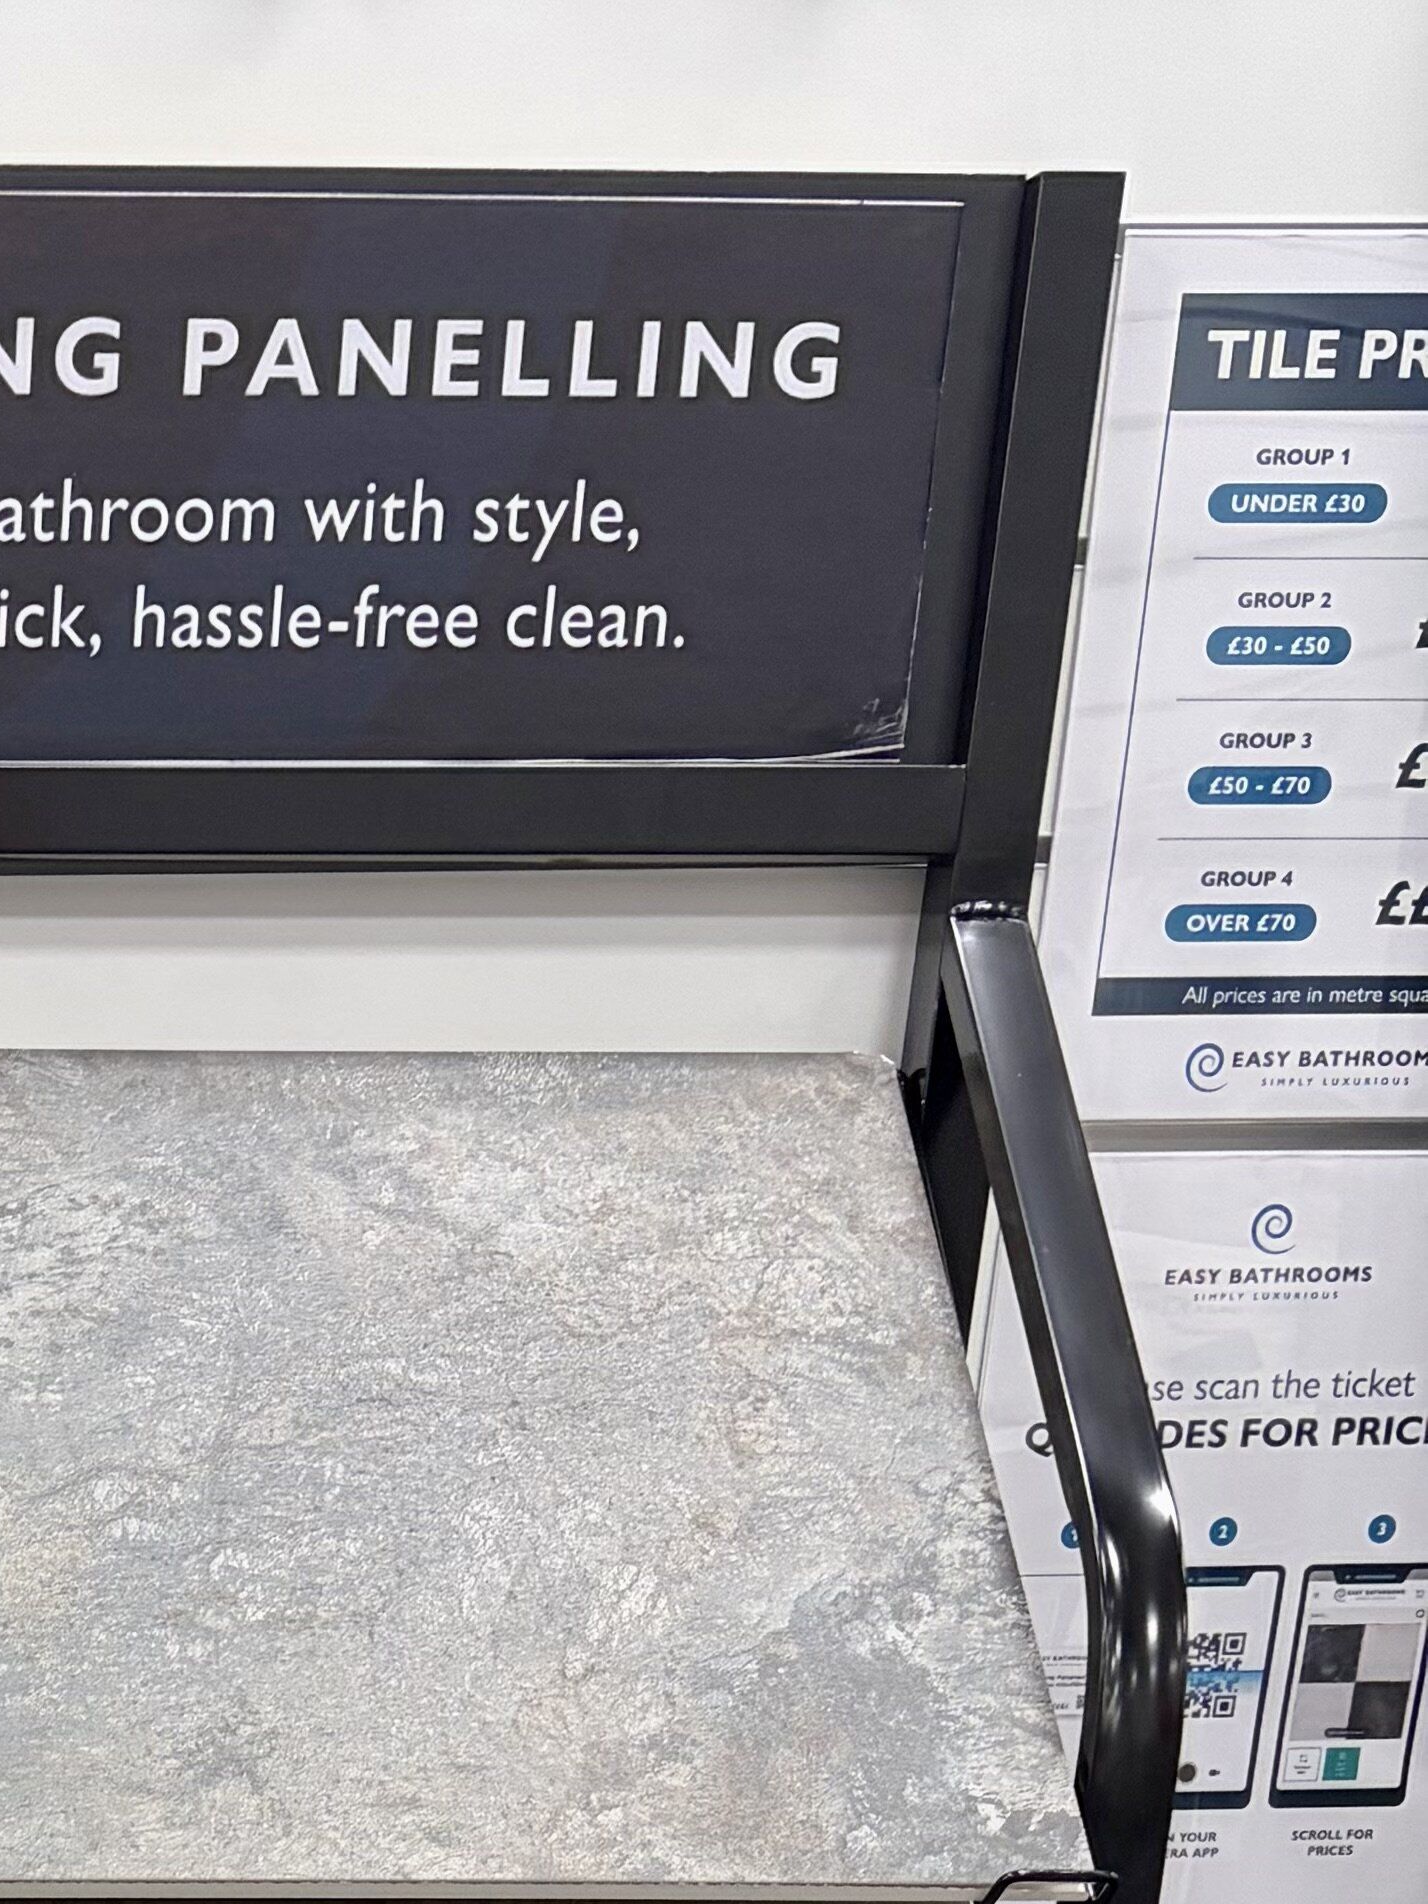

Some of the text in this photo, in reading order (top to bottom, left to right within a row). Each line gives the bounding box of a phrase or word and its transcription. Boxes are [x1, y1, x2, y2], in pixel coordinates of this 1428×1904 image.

[183, 318, 839, 399] PANELLING
[1208, 330, 1428, 378] TILE PR
[1257, 449, 1349, 465] GROUP 1
[1232, 494, 1365, 512] UNDER £30
[305, 479, 443, 541] with
[474, 479, 638, 562] style,
[1238, 592, 1331, 608] GROUP 2
[134, 585, 478, 647] hassle-free
[507, 585, 684, 647] clean.
[1228, 637, 1267, 654] £30
[1291, 637, 1329, 654] £50
[1220, 733, 1312, 748] GROUP 3
[1209, 777, 1248, 794] £50
[1271, 777, 1310, 794] £70
[1201, 871, 1292, 886] GROUP 4
[1187, 914, 1295, 932] OVER £70
[1182, 987, 1428, 1008] All prices are in metre squa
[1232, 1051, 1290, 1067] EASY
[1261, 1077, 1408, 1086] SIMPLY LUXURIOUS
[1165, 1266, 1372, 1285] EASY BATHROOMS
[1194, 1291, 1338, 1301] SIMPLY LUXURIOUS
[1194, 1379, 1259, 1400] scan
[1272, 1370, 1320, 1398] the
[1332, 1367, 1416, 1398] ticket
[1240, 1418, 1318, 1447] FOR
[1332, 1416, 1428, 1446] PRIC
[1218, 1524, 1228, 1539] 2
[1377, 1521, 1387, 1536] 3
[1180, 1832, 1216, 1842] YOUR
[1292, 1829, 1373, 1841] SCROLL FOR
[1192, 1848, 1219, 1857] APP
[1308, 1845, 1353, 1856] PRICES
